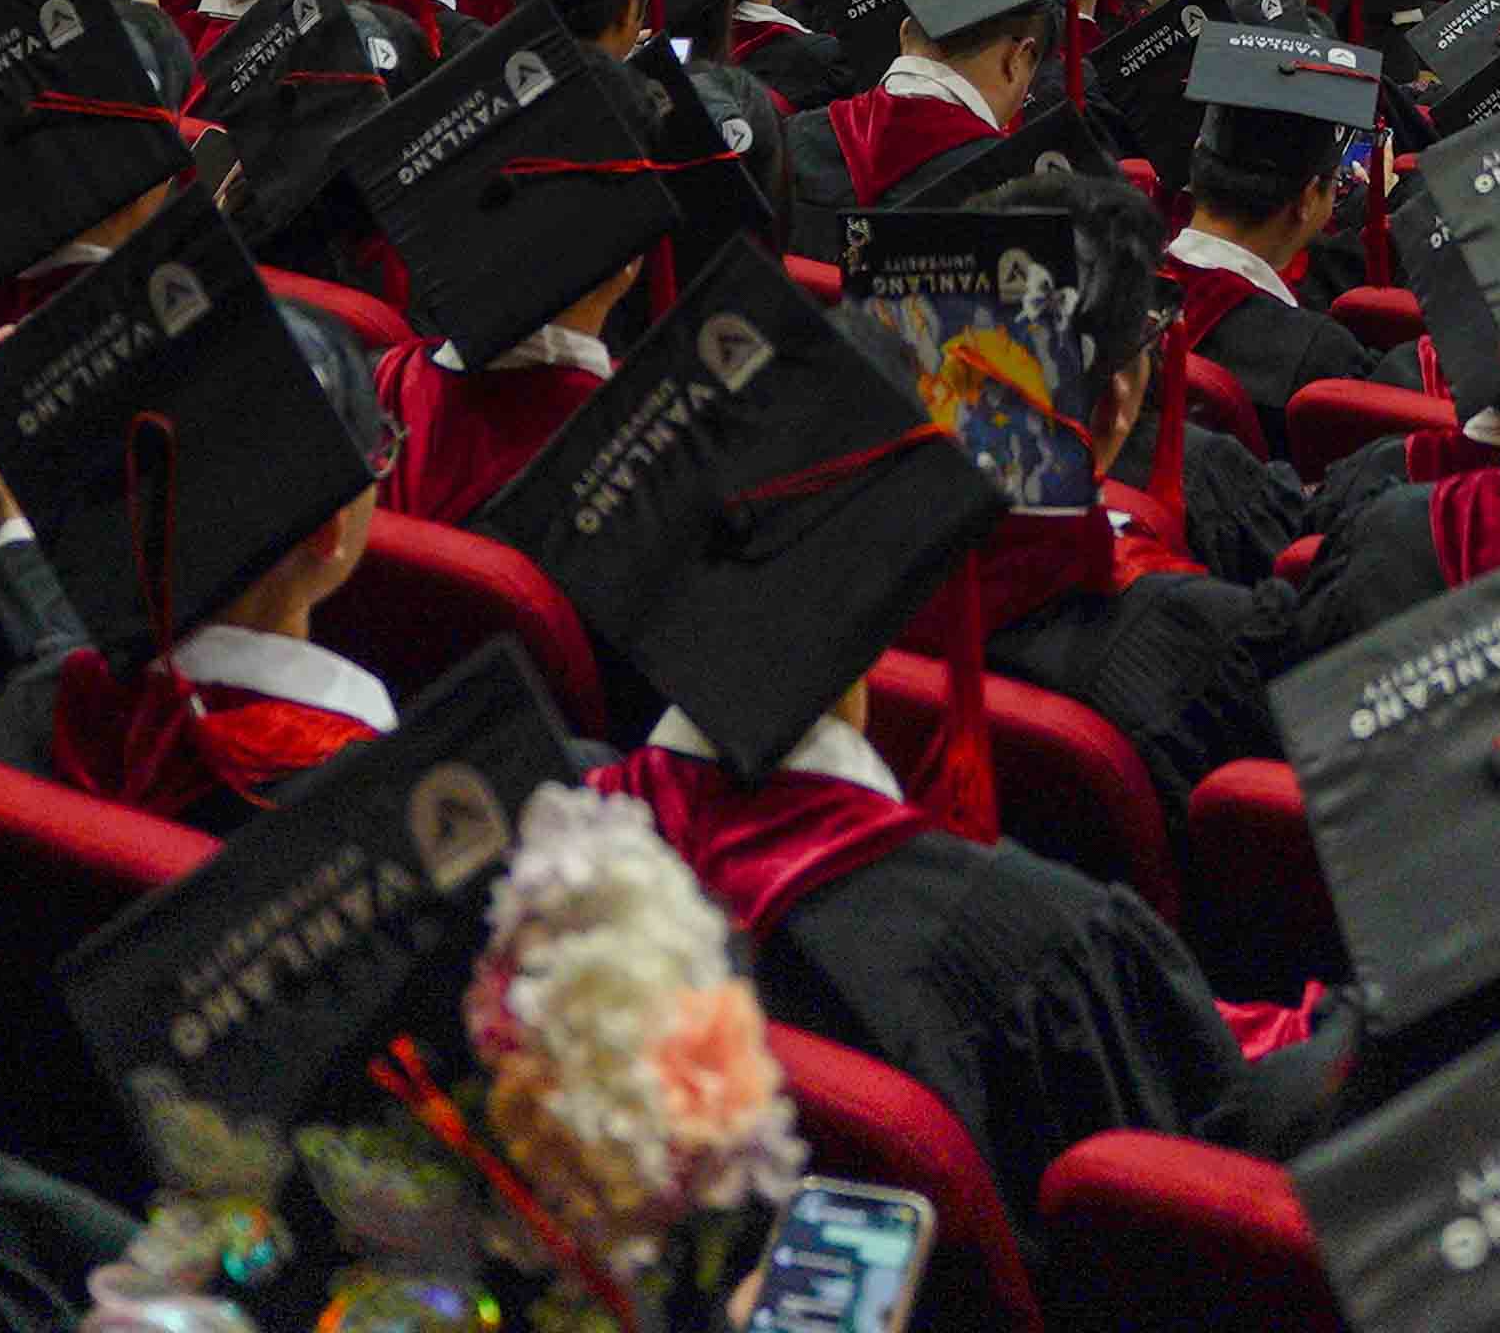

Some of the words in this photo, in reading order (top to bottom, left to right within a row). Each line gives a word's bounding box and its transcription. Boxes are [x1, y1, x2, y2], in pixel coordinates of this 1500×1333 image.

[230, 23, 296, 94] VANLANG
[1119, 24, 1186, 77] VANLANG
[397, 97, 510, 186] VANLANG
[874, 272, 992, 298] VANLANG
[16, 321, 152, 437] VANLANG
[574, 381, 716, 534] VANLANG
[171, 862, 420, 1058] VANLANG
